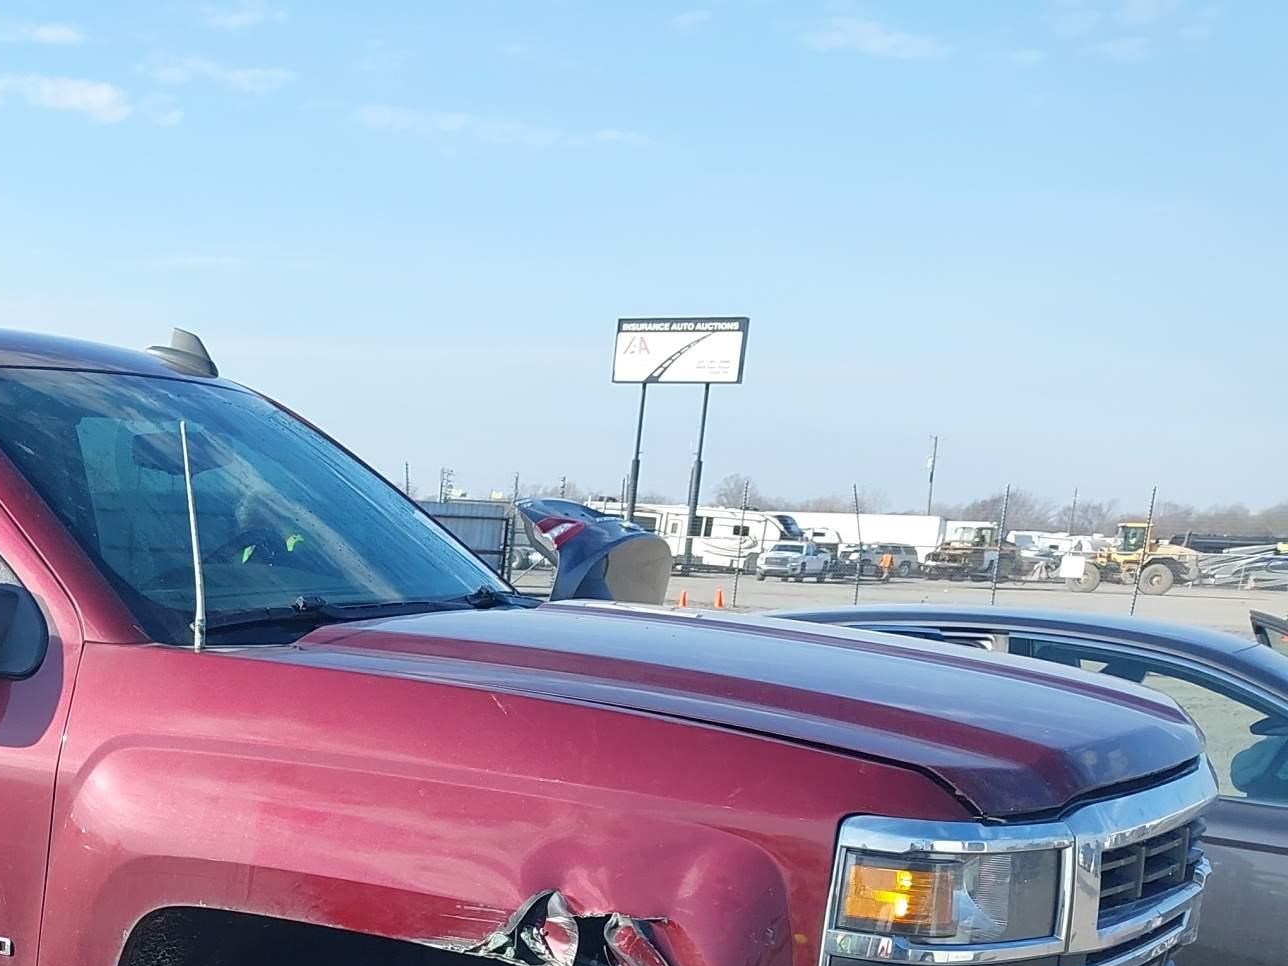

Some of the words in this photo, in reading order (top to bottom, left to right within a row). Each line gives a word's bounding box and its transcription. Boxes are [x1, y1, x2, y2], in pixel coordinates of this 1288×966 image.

[622, 322, 670, 331] INSURANCE
[671, 322, 695, 331] AUTO
[695, 321, 739, 331] AUCTIONS
